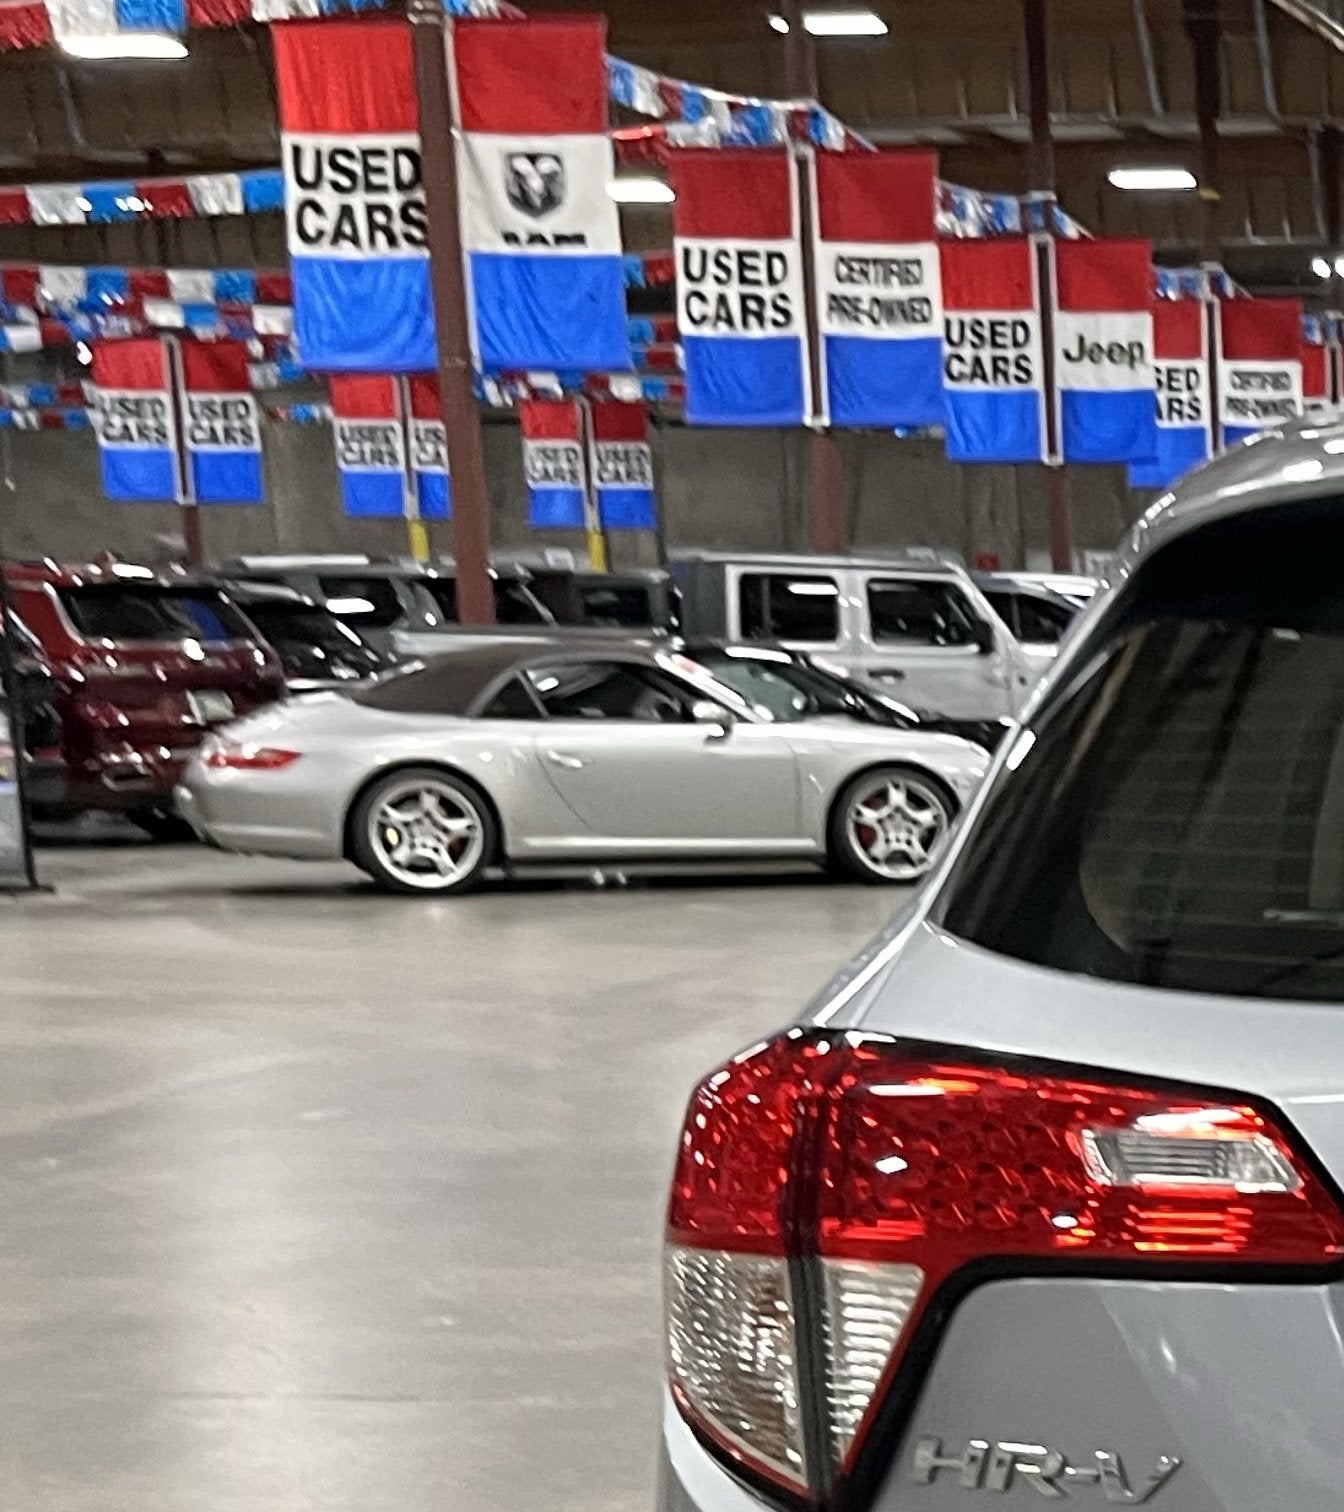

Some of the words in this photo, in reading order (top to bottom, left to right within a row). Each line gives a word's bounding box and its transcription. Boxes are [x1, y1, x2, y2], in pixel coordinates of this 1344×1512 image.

[292, 144, 422, 193] USED
[296, 199, 427, 248] CARS
[682, 247, 788, 286] USED
[835, 254, 923, 286] CERTIFIED
[685, 290, 793, 329] CARS
[945, 318, 1031, 350] USED
[1062, 333, 1145, 369] Jeep
[945, 352, 1033, 385] CARS
[912, 1436, 1185, 1504] HR-V
